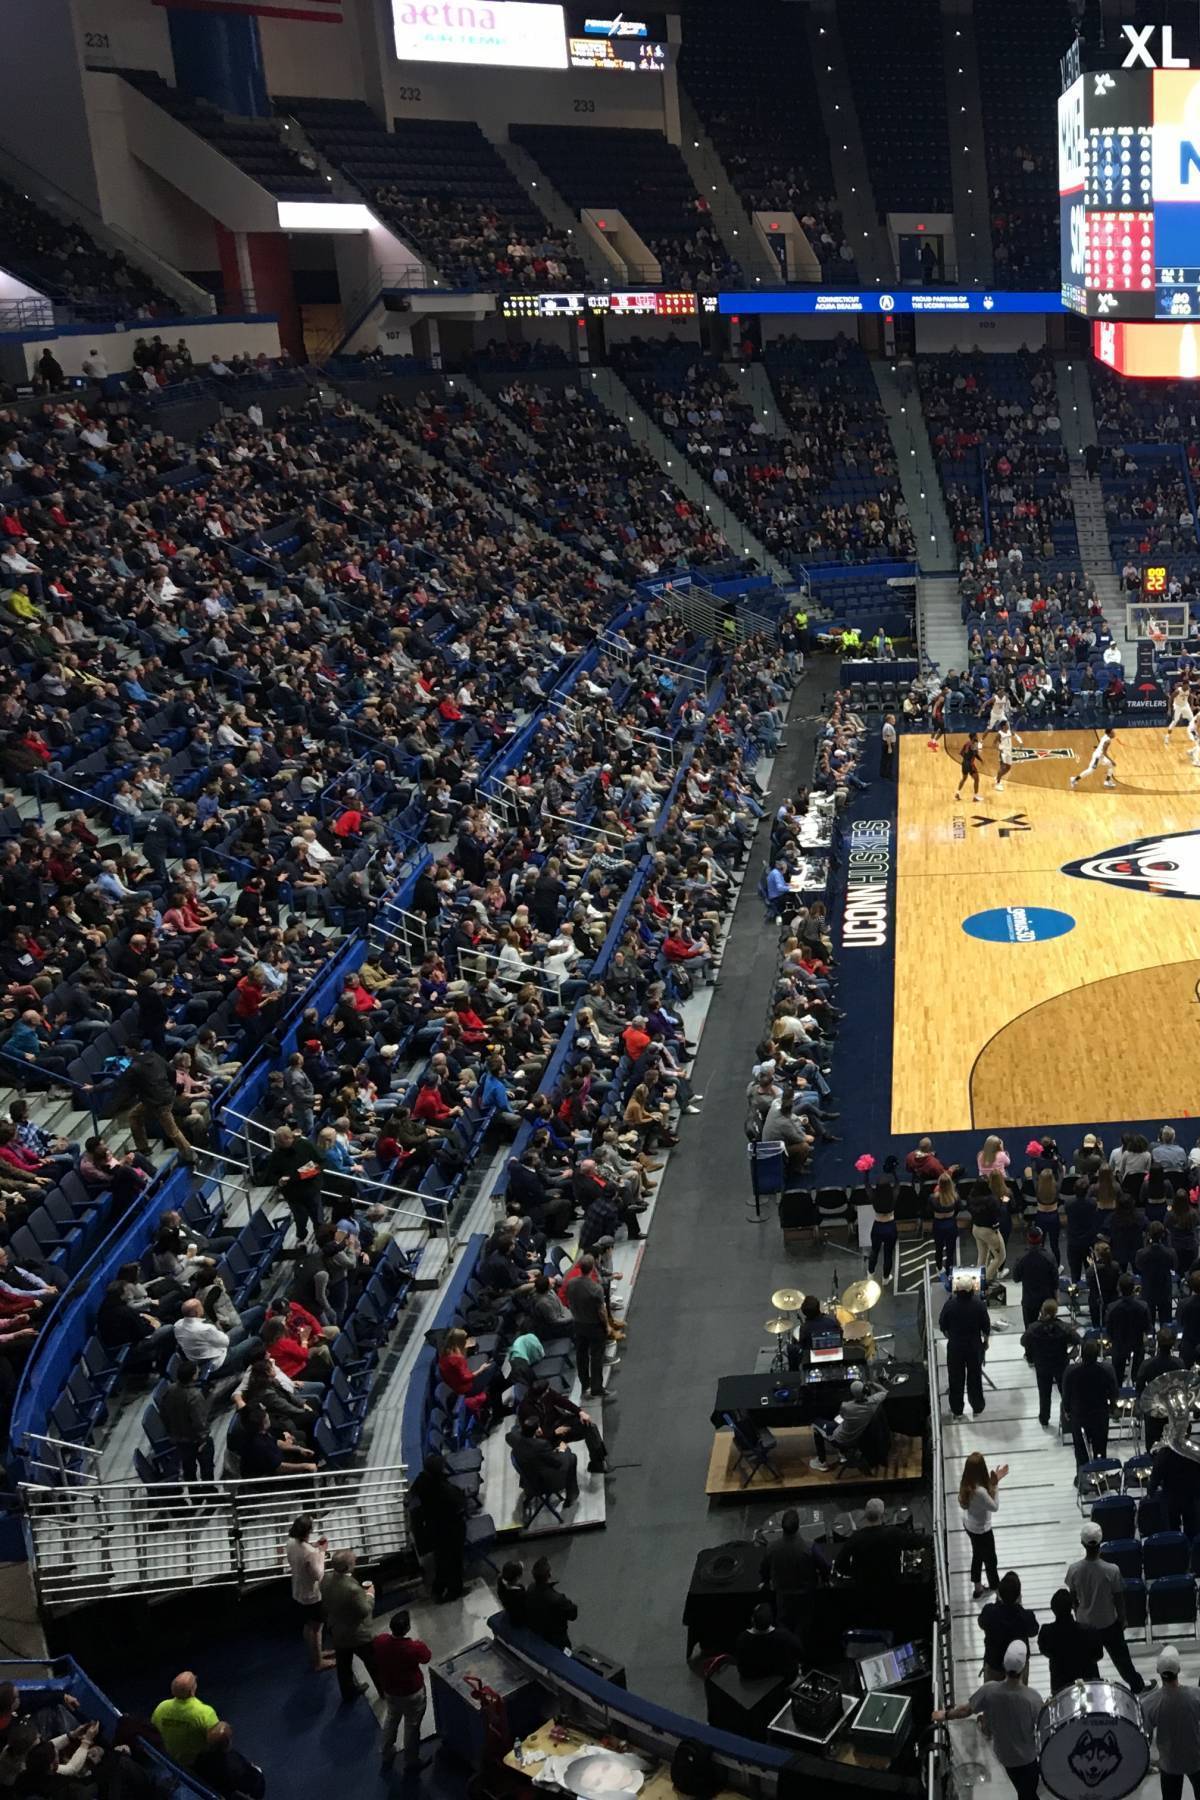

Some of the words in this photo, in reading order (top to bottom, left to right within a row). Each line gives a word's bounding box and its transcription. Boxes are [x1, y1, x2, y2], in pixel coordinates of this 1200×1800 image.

[401, 0, 496, 29] aetna
[85, 32, 109, 48] 231
[1121, 25, 1190, 68] XL
[400, 87, 421, 101] 232
[574, 100, 594, 112] 233
[386, 331, 400, 340] 107
[1147, 577, 1164, 591] 22
[849, 819, 891, 886] HUSKIES
[842, 884, 887, 948] UCONN
